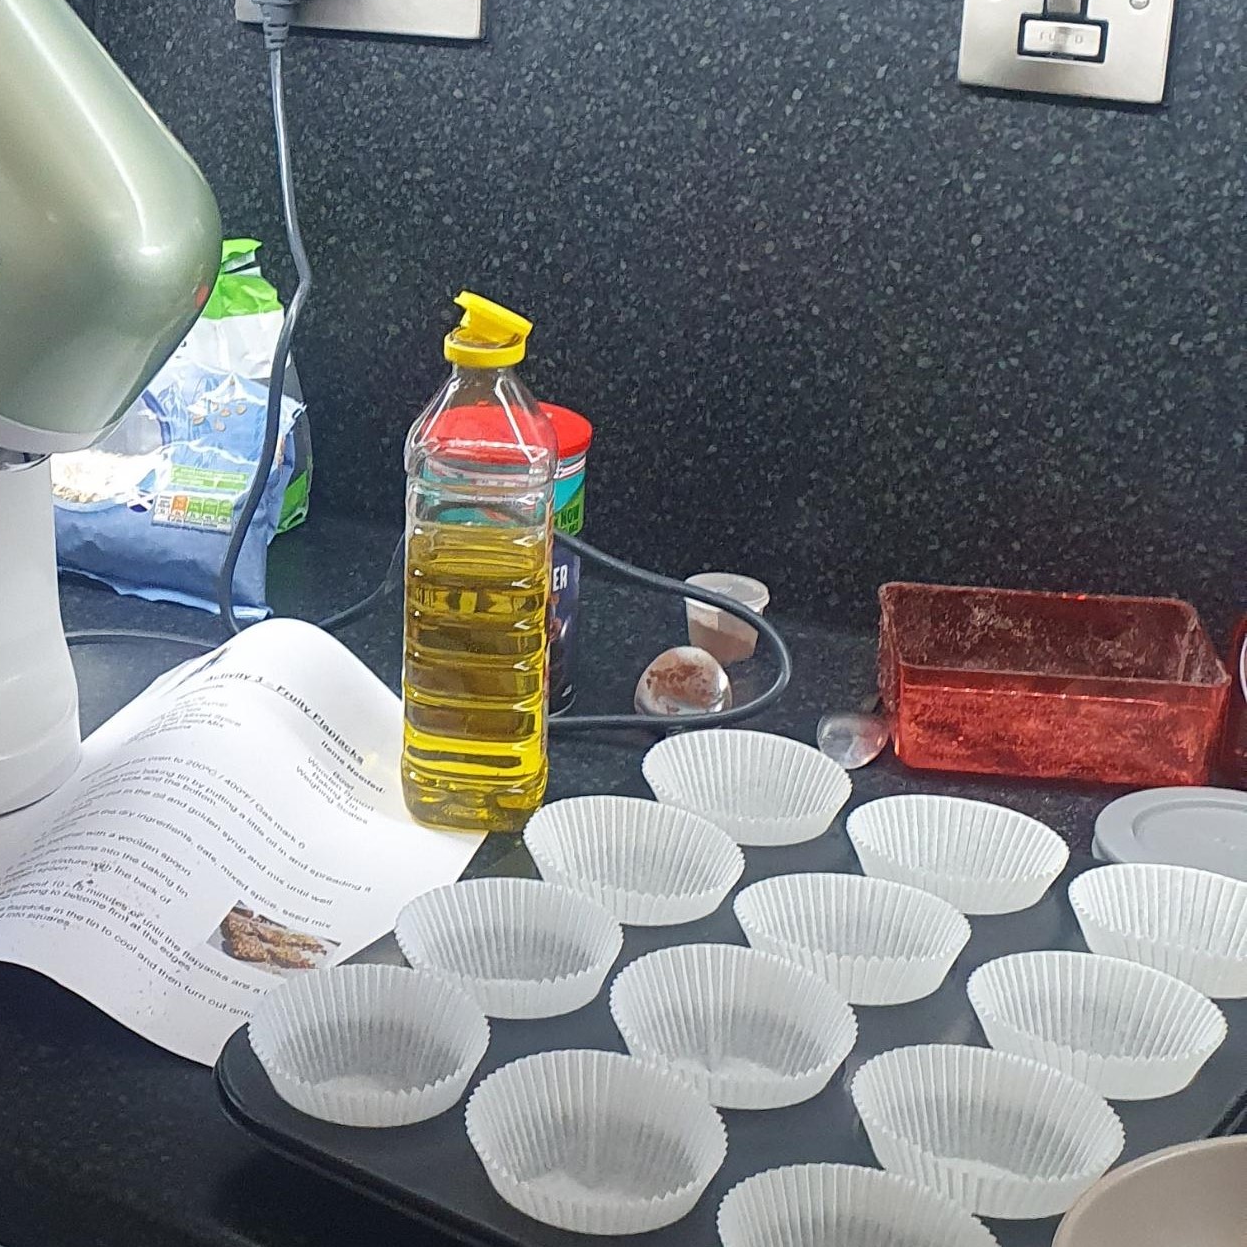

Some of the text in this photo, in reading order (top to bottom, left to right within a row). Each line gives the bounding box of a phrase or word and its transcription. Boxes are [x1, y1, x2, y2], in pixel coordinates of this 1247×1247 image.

[276, 685, 311, 714] Fruity
[313, 713, 364, 765] Flapjacks
[164, 778, 181, 787] the
[118, 835, 160, 854] wooden
[160, 851, 192, 877] spoon
[167, 796, 188, 809] and
[187, 806, 221, 832] golden
[222, 830, 247, 855] syrup
[247, 854, 267, 872] and
[267, 871, 285, 885] mix
[286, 883, 310, 898] until
[205, 787, 238, 813] putting
[246, 818, 265, 837] little
[288, 855, 309, 871] and
[274, 822, 296, 843] mark
[114, 865, 133, 880] the
[132, 875, 158, 896] back
[158, 895, 172, 905] of
[121, 852, 140, 864] the
[140, 860, 174, 888] baking
[175, 884, 189, 898] tin
[220, 864, 249, 891] mixed
[282, 908, 309, 923] seed
[63, 891, 106, 910] become
[130, 921, 142, 932] at
[143, 928, 159, 946] the
[85, 887, 130, 912] minutes
[142, 918, 165, 940] until
[164, 934, 181, 952] the
[182, 950, 230, 983] flapjacks
[231, 978, 251, 991] are
[65, 910, 84, 922] the
[85, 917, 100, 930] tin
[101, 925, 112, 937] to
[114, 934, 138, 954] cool
[137, 951, 158, 971] and
[158, 968, 182, 989] then
[184, 984, 207, 1002] turn
[207, 998, 228, 1011] out
